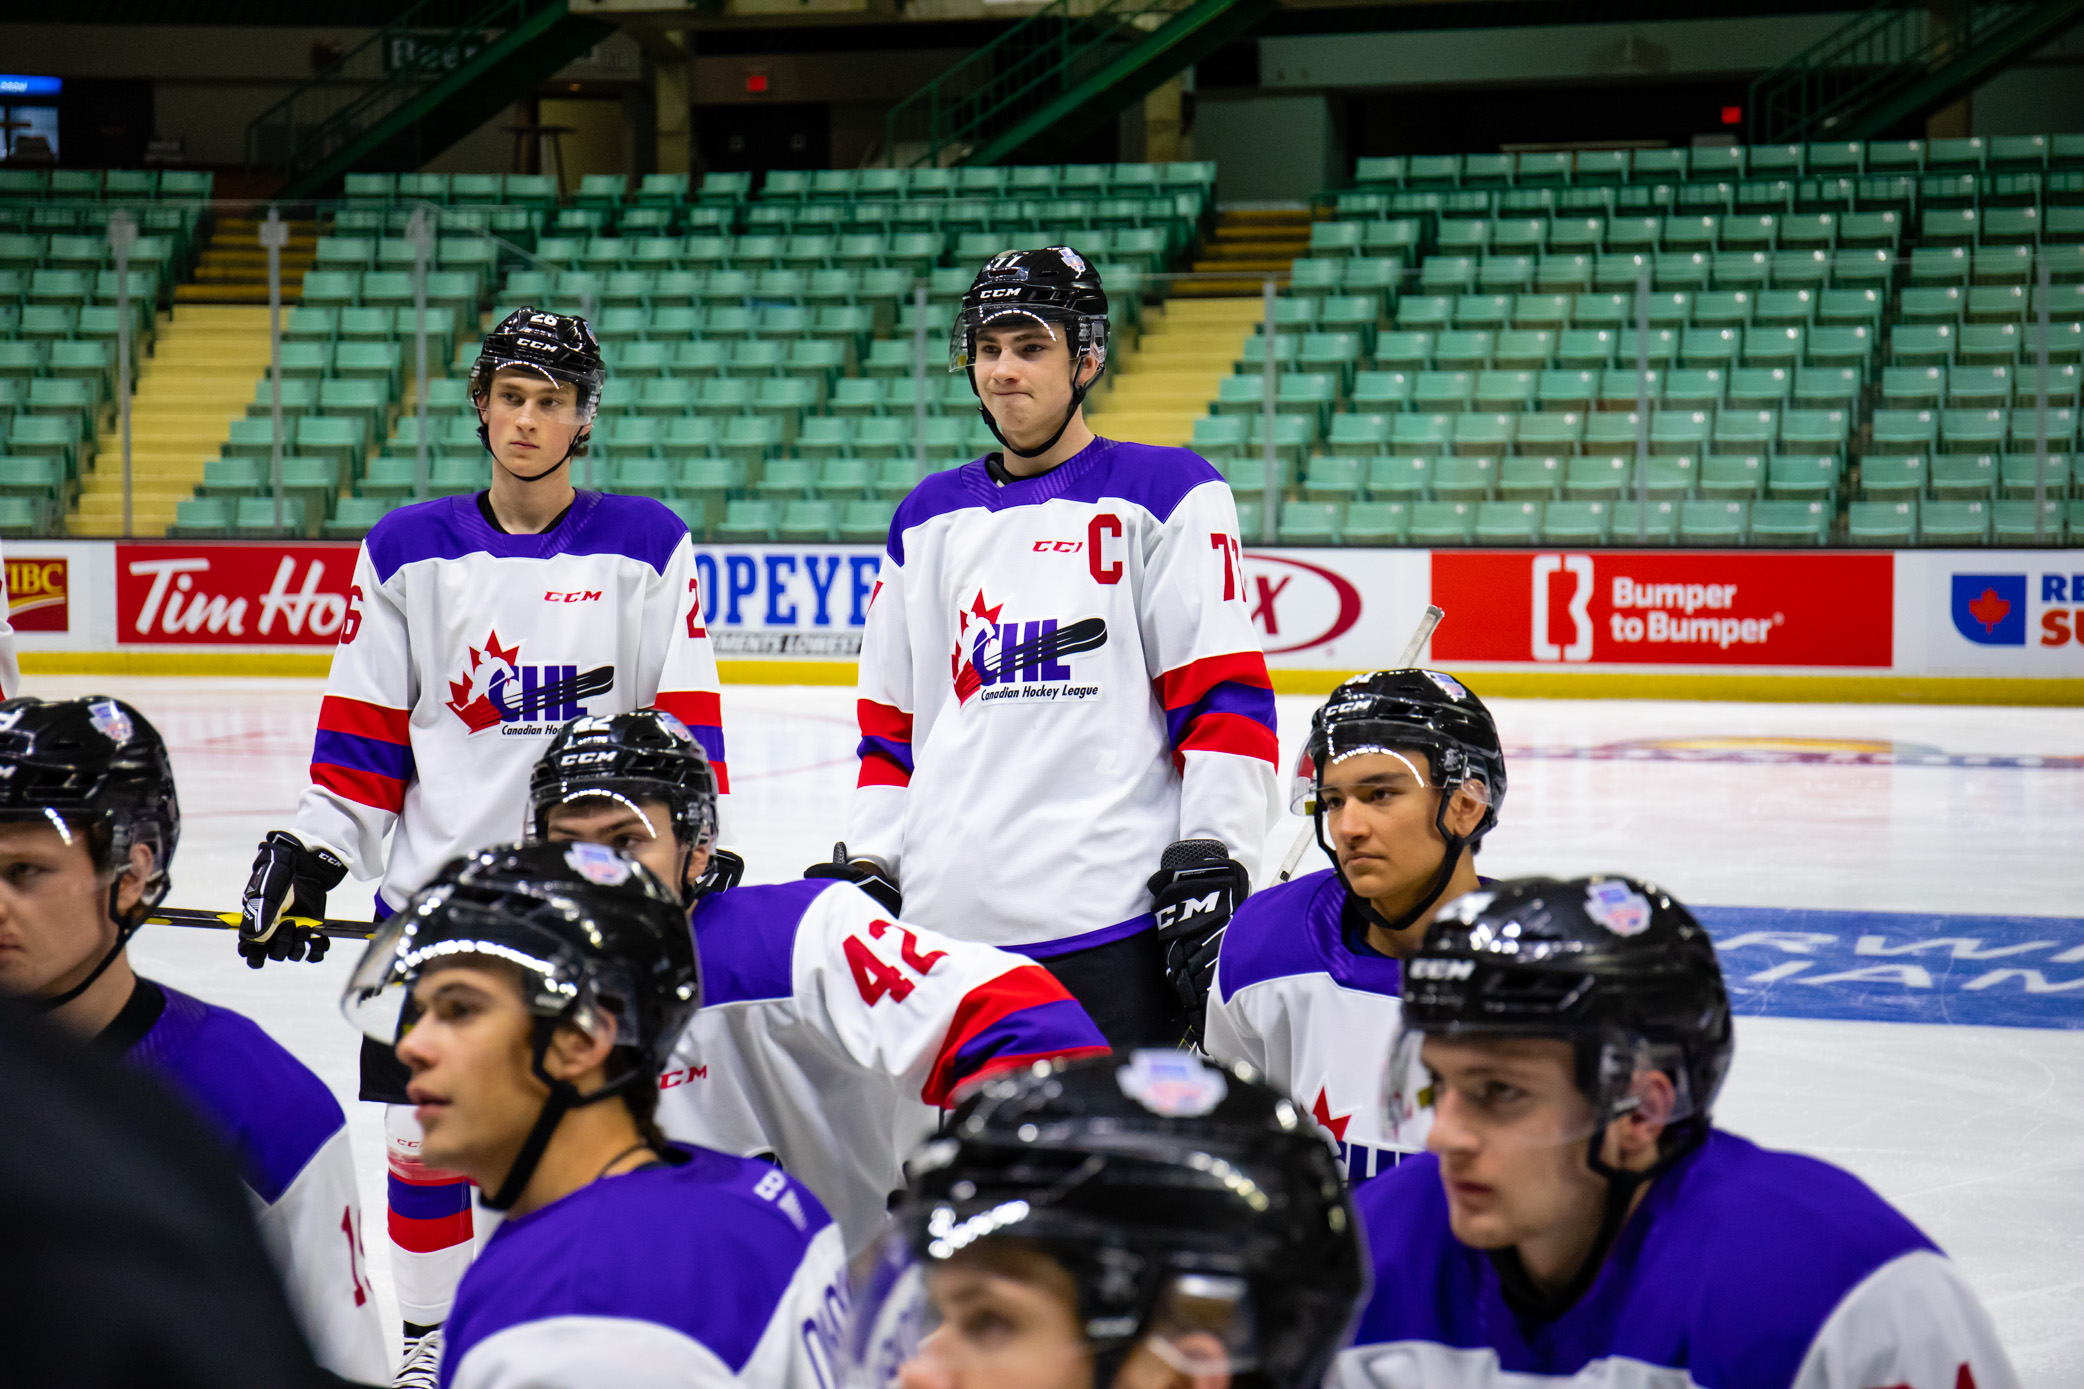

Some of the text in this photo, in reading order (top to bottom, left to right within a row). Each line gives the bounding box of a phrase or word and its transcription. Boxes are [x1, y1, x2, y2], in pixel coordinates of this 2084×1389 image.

[980, 287, 1022, 299] CCM
[516, 337, 559, 353] CCM
[1088, 513, 1123, 585] C
[6, 562, 65, 595] IBC
[129, 557, 249, 636] Tim
[544, 590, 603, 603] CCM
[686, 578, 711, 639] 2
[1612, 576, 1737, 615] Bumper
[1610, 610, 1773, 649] to Bumper
[972, 618, 1071, 687] CHL
[488, 665, 588, 722] CHL
[981, 684, 1099, 701] Canadian Hockey League
[1325, 700, 1372, 717] CCM
[502, 724, 542, 737] Canadian
[560, 751, 618, 767] CCM
[842, 919, 950, 1008] 42
[1408, 958, 1477, 981] CCM
